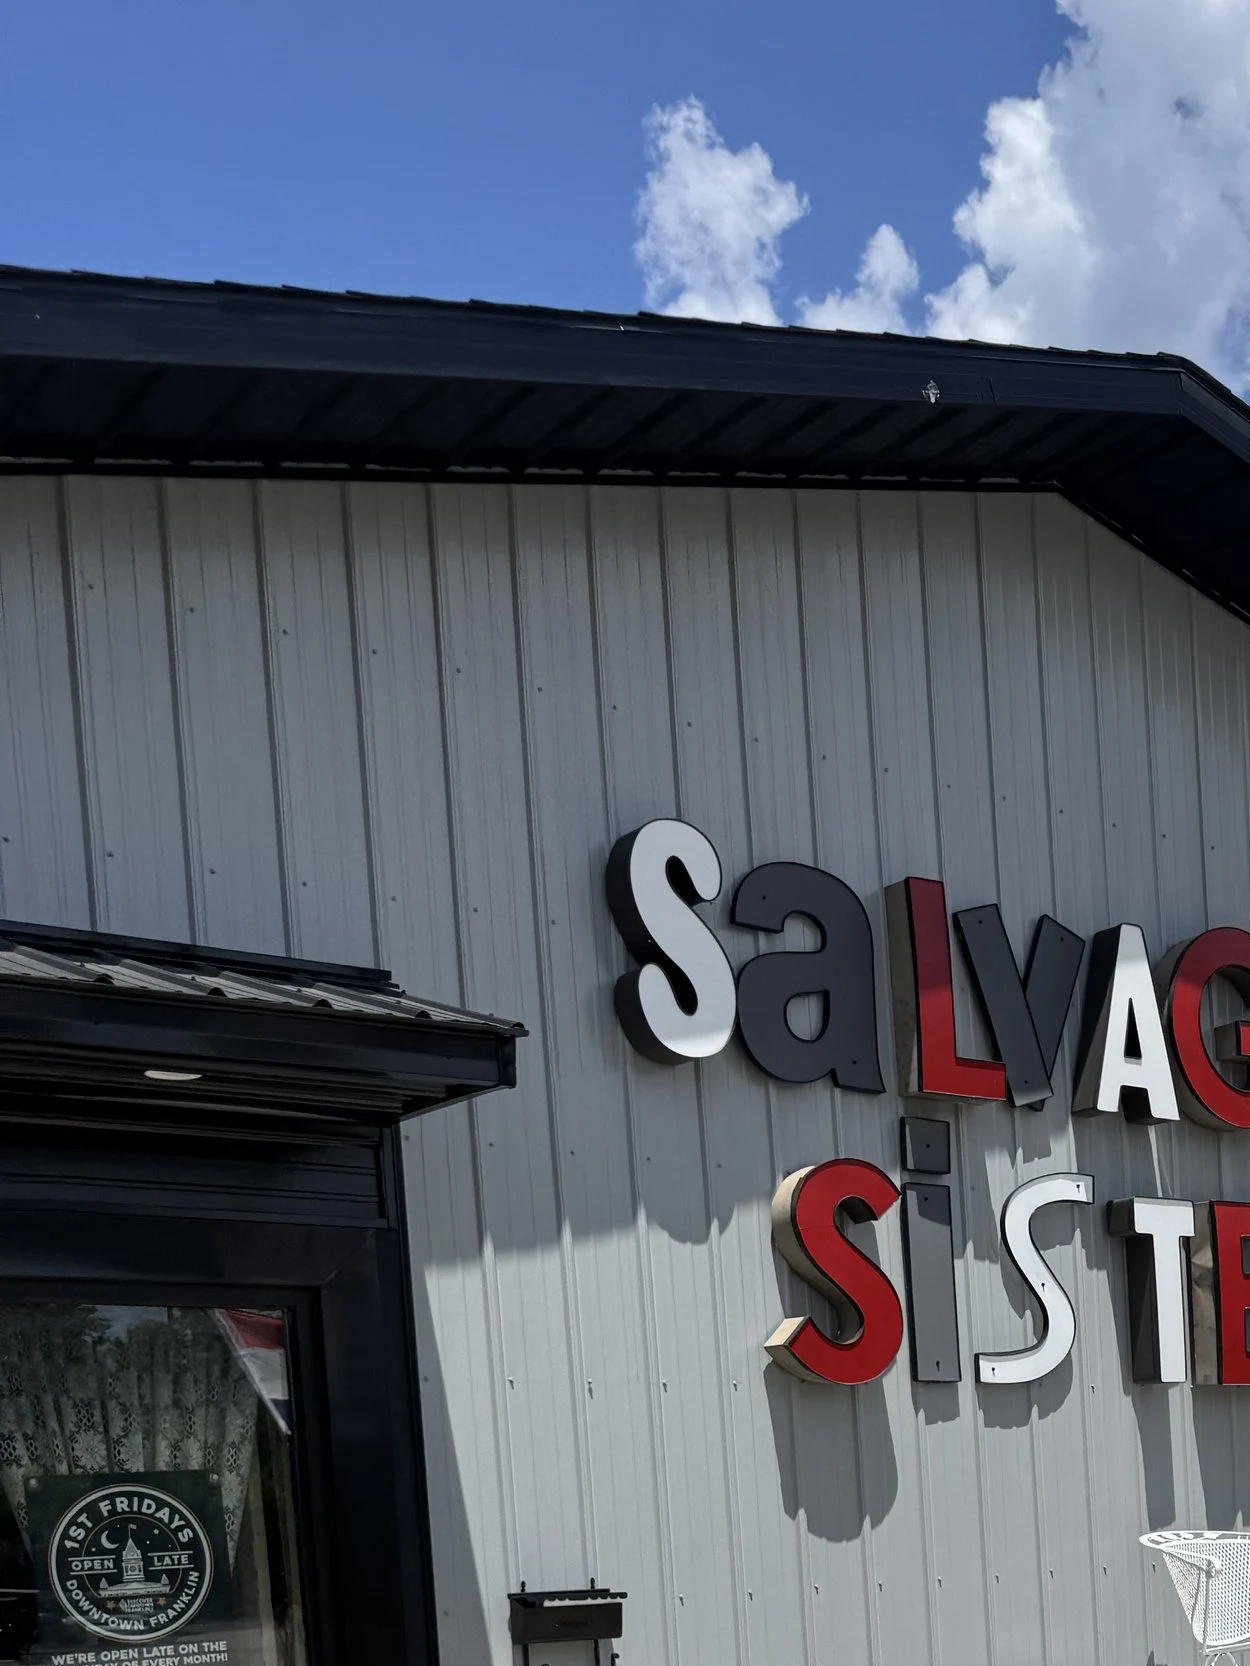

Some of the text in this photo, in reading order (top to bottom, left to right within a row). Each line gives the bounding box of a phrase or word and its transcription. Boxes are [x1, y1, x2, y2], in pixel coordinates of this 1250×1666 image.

[64, 1497, 194, 1549] 1ST FRIDAYS
[71, 1554, 189, 1571] OPEN LATE
[66, 1571, 200, 1630] DOWNTOWN FRANKLIN
[52, 1641, 228, 1666] WE'RE OPEN LATE ON THE
[183, 1652, 228, 1665] MONTH!
